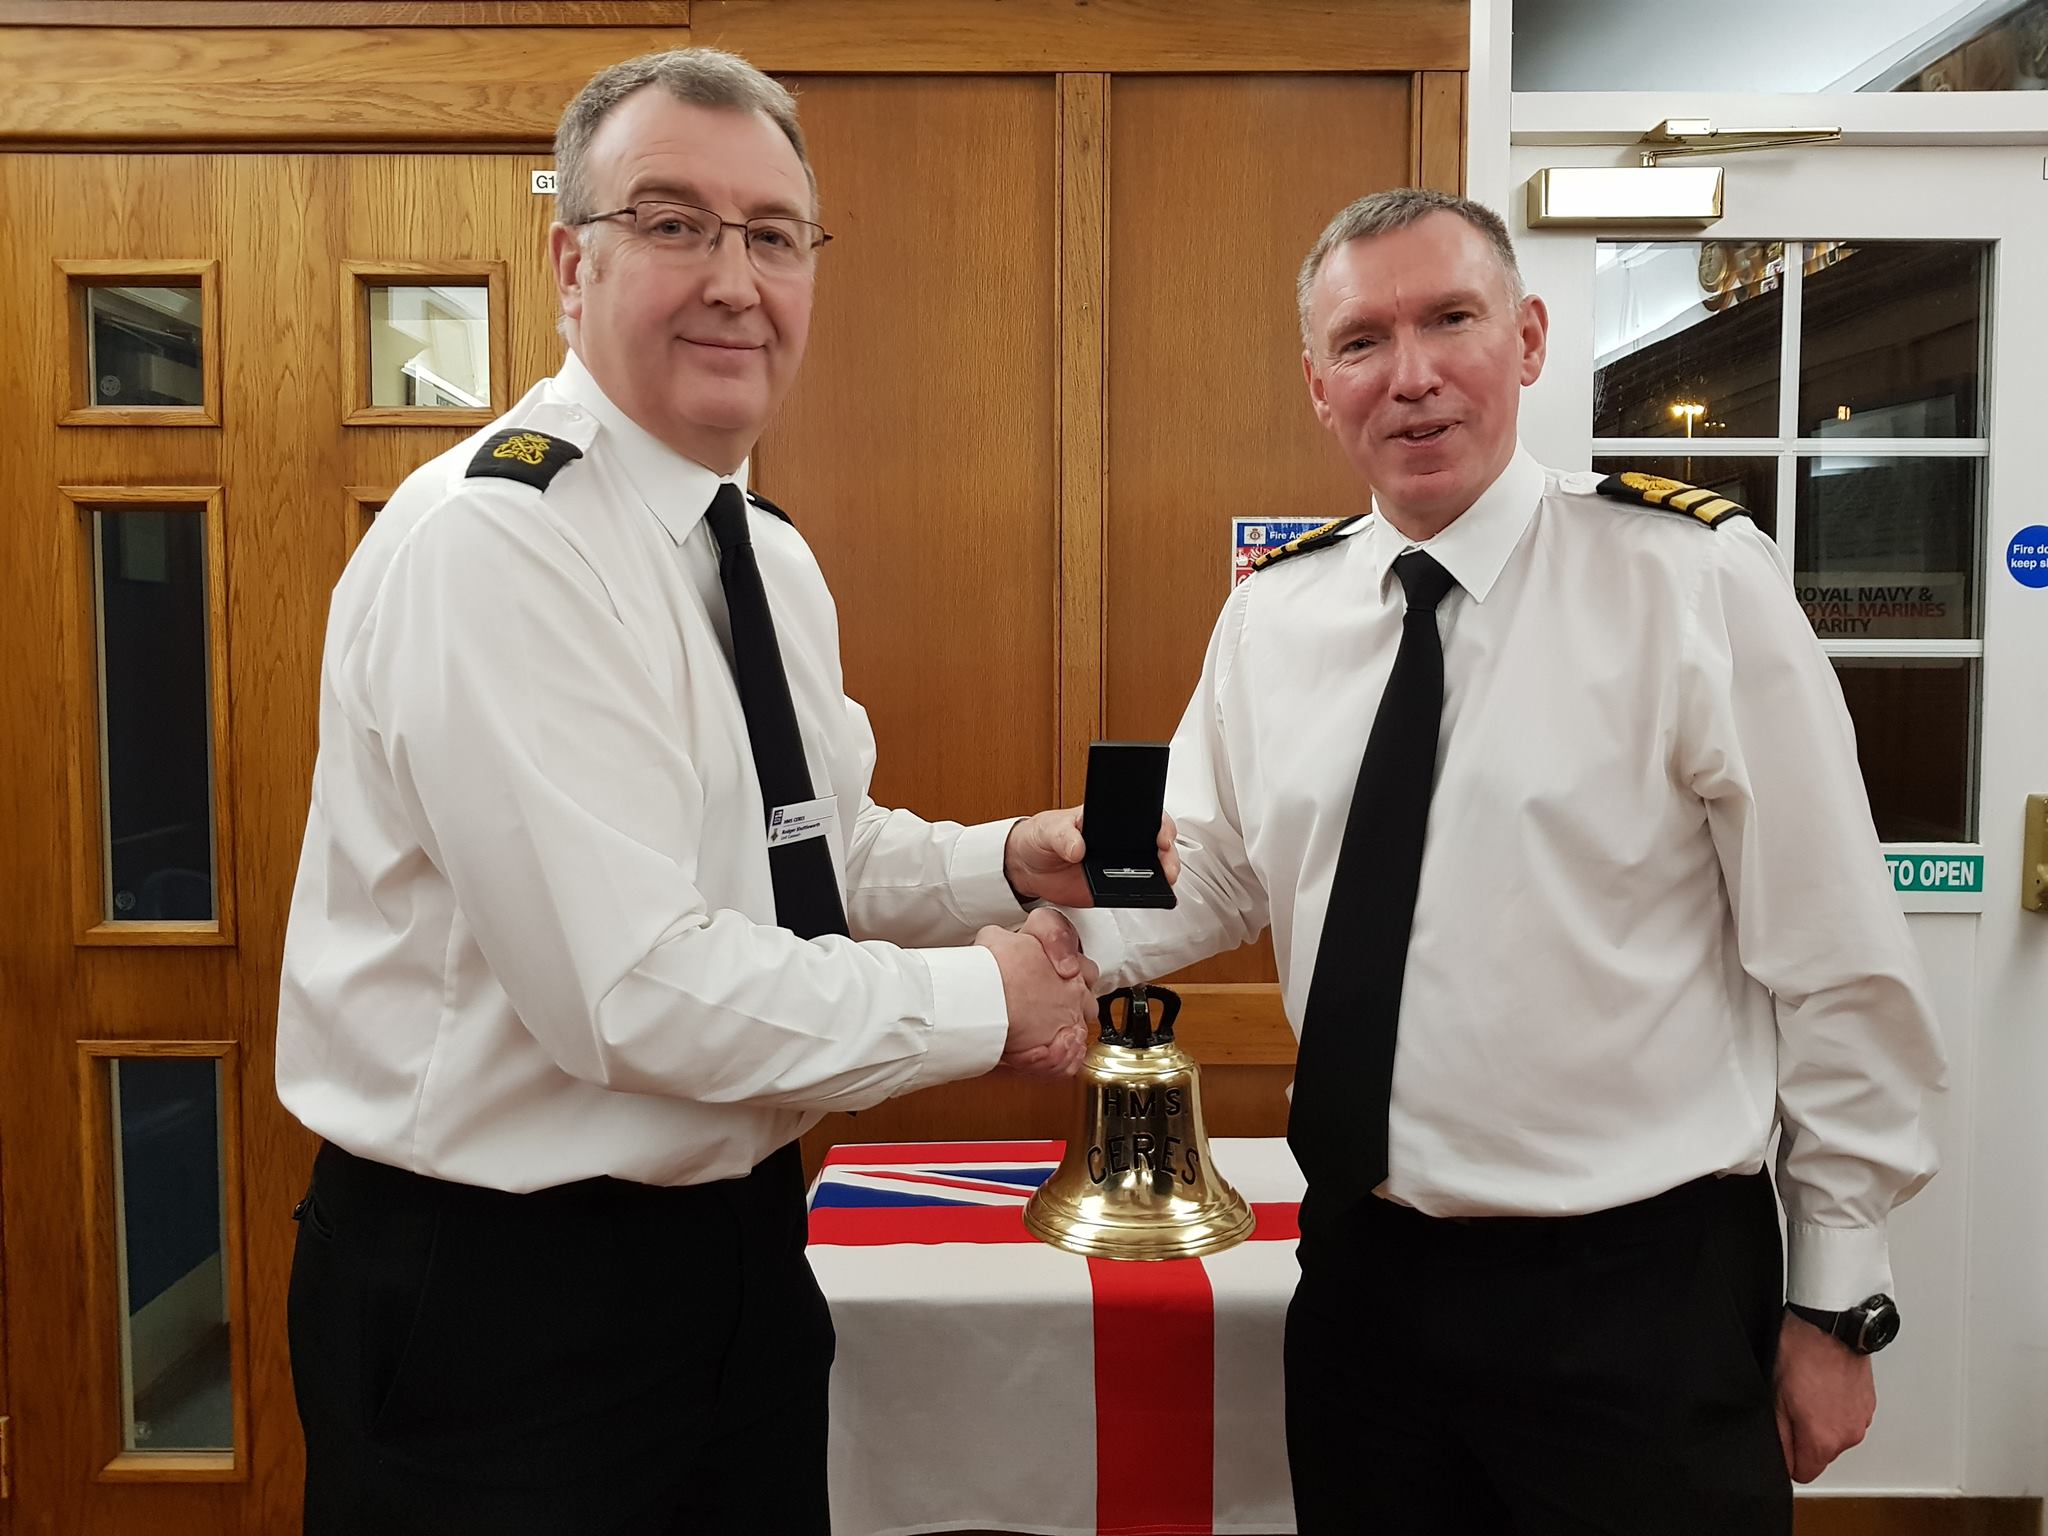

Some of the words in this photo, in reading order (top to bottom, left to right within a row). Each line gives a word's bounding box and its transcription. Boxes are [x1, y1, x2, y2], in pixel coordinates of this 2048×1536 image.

[1269, 531, 1287, 540] Fire
[1289, 531, 1301, 540] Ac
[2013, 544, 2035, 554] Fire
[2010, 557, 2037, 570] keep
[1858, 587, 1913, 601] NAVY
[1918, 587, 1934, 601] &
[1802, 602, 1852, 617] OYAL
[1858, 602, 1945, 617] MARINES
[1811, 618, 1872, 633] ARITY
[1886, 860, 1914, 886] TO
[1919, 860, 1975, 887] OPEN
[1087, 1132, 1200, 1185] CERES
